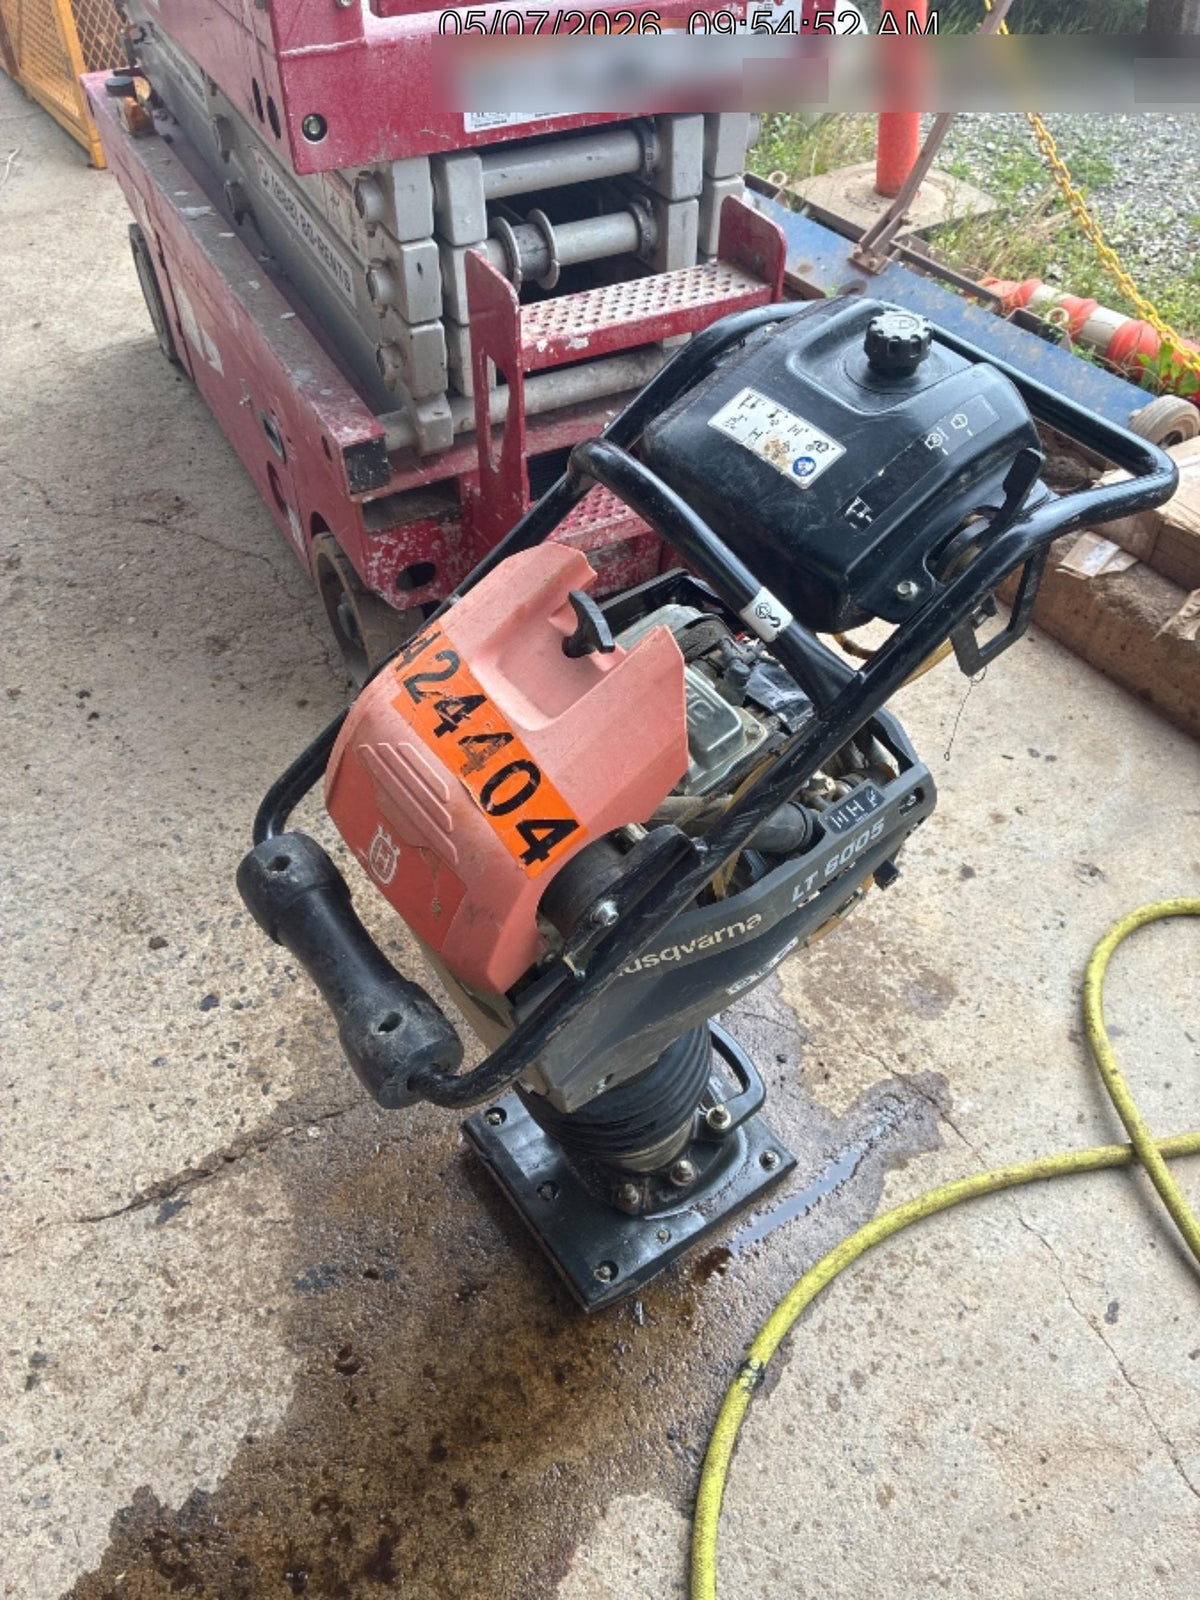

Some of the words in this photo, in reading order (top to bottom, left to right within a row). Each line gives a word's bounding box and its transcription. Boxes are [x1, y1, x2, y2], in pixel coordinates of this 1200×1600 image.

[792, 870, 819, 902] LT
[824, 816, 886, 878] 6005
[618, 912, 763, 977] usqvarna
